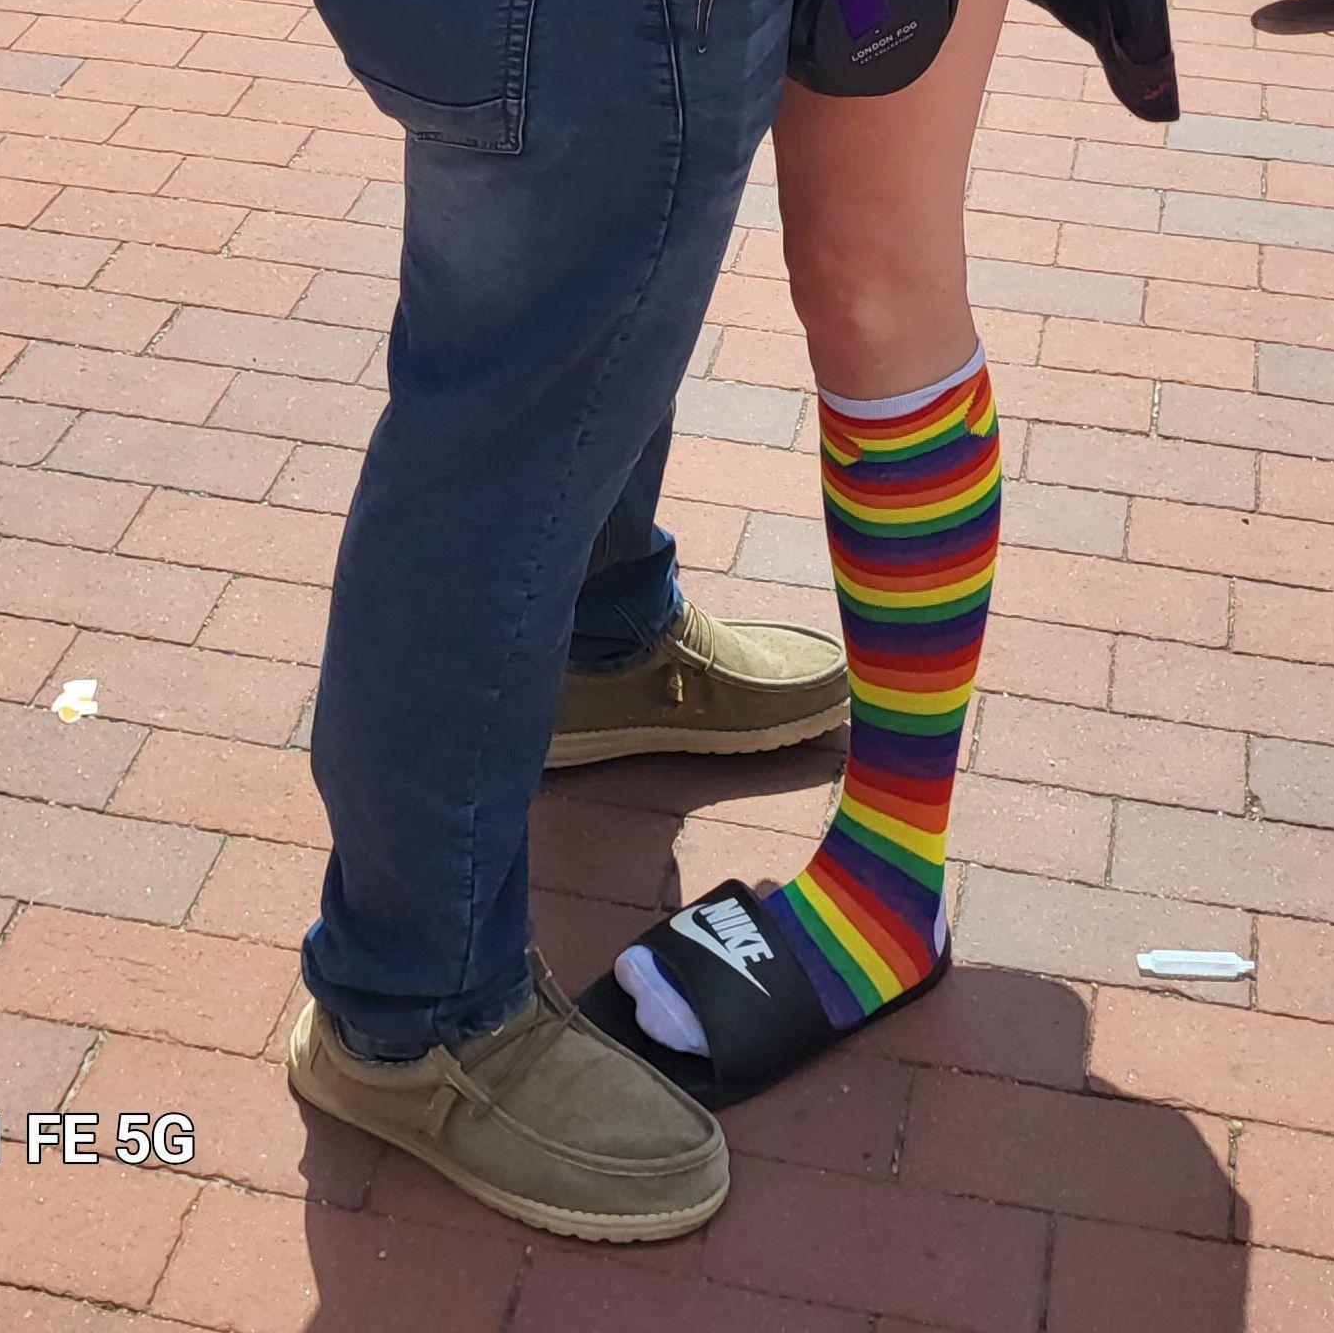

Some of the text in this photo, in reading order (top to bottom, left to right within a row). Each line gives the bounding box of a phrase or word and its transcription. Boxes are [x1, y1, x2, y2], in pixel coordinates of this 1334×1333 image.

[851, 34, 894, 62] LONDON
[896, 21, 918, 37] FOG
[699, 897, 774, 967] NIKE
